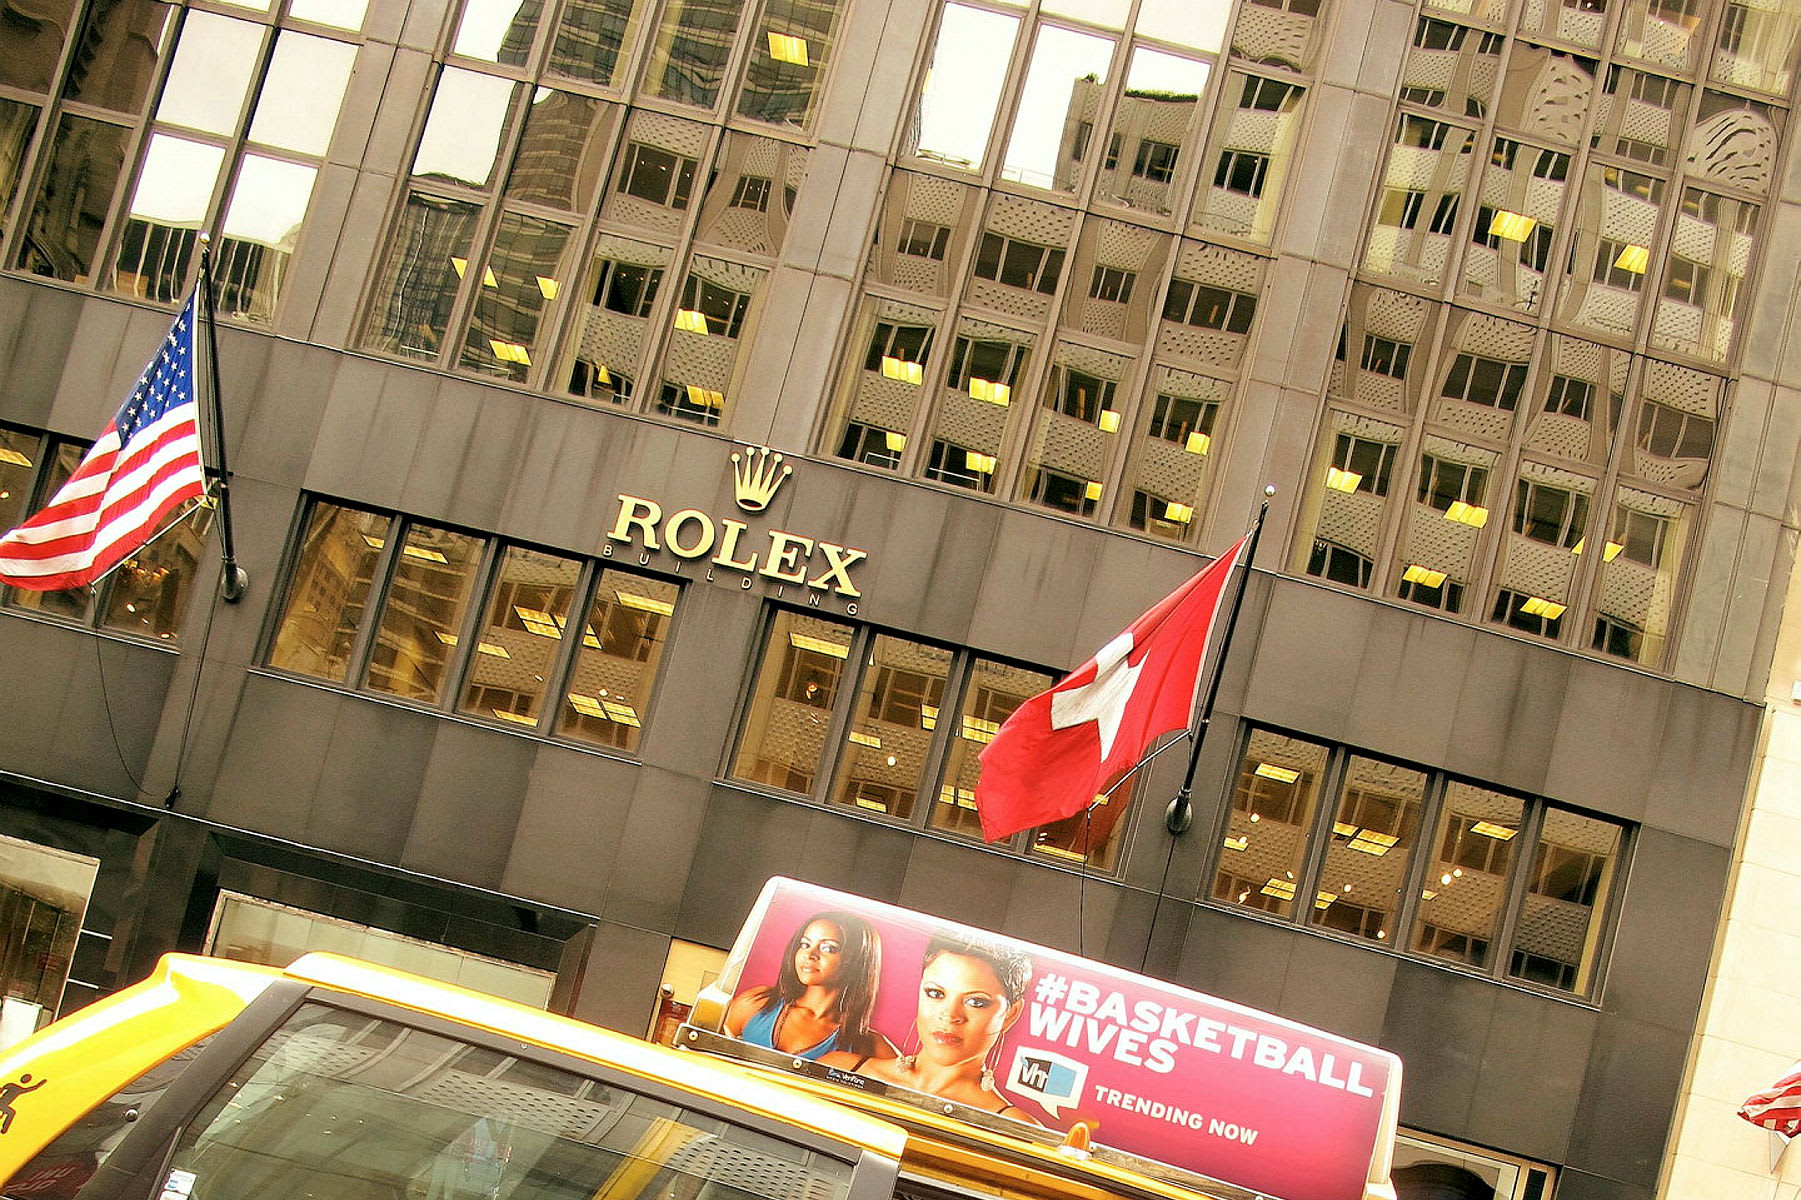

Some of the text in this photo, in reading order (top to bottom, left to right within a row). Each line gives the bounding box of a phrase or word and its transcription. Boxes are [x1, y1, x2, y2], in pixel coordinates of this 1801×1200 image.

[602, 544, 859, 615] BUILDING
[607, 493, 868, 598] ROLEX
[1029, 1002, 1179, 1075] WIVES
[1035, 972, 1375, 1098] #BASKETBALL
[1094, 1085, 1259, 1146] TRENDING NOW
